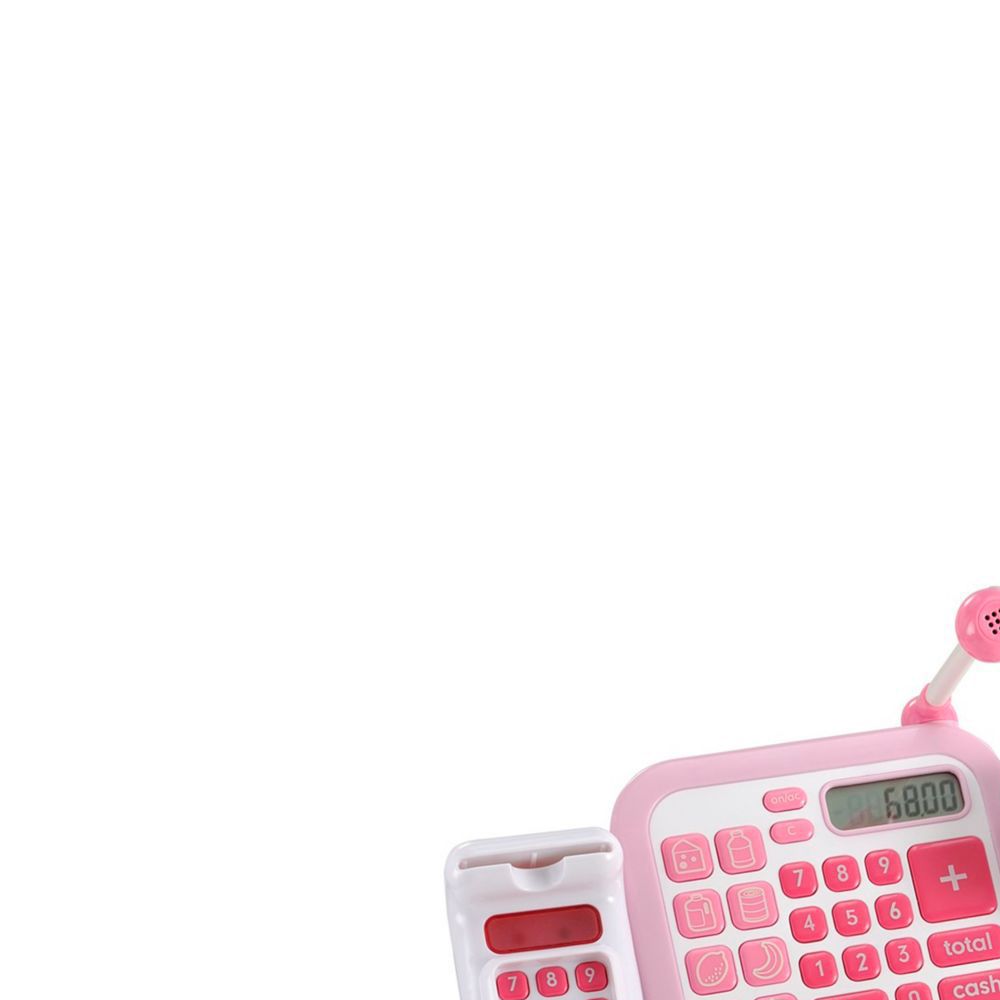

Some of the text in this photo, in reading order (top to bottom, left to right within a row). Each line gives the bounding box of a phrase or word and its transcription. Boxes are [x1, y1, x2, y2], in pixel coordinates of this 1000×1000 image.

[836, 864, 849, 882] 8
[877, 856, 890, 875] 9
[792, 868, 804, 888] 7
[846, 909, 858, 926] 5
[889, 901, 901, 920] 6
[803, 914, 816, 932] 4
[943, 932, 993, 957] total
[855, 953, 869, 972] 2
[897, 945, 911, 963] 3
[584, 967, 595, 983] 9
[814, 959, 825, 977] 1
[507, 976, 518, 992] 7
[546, 972, 558, 987] 8
